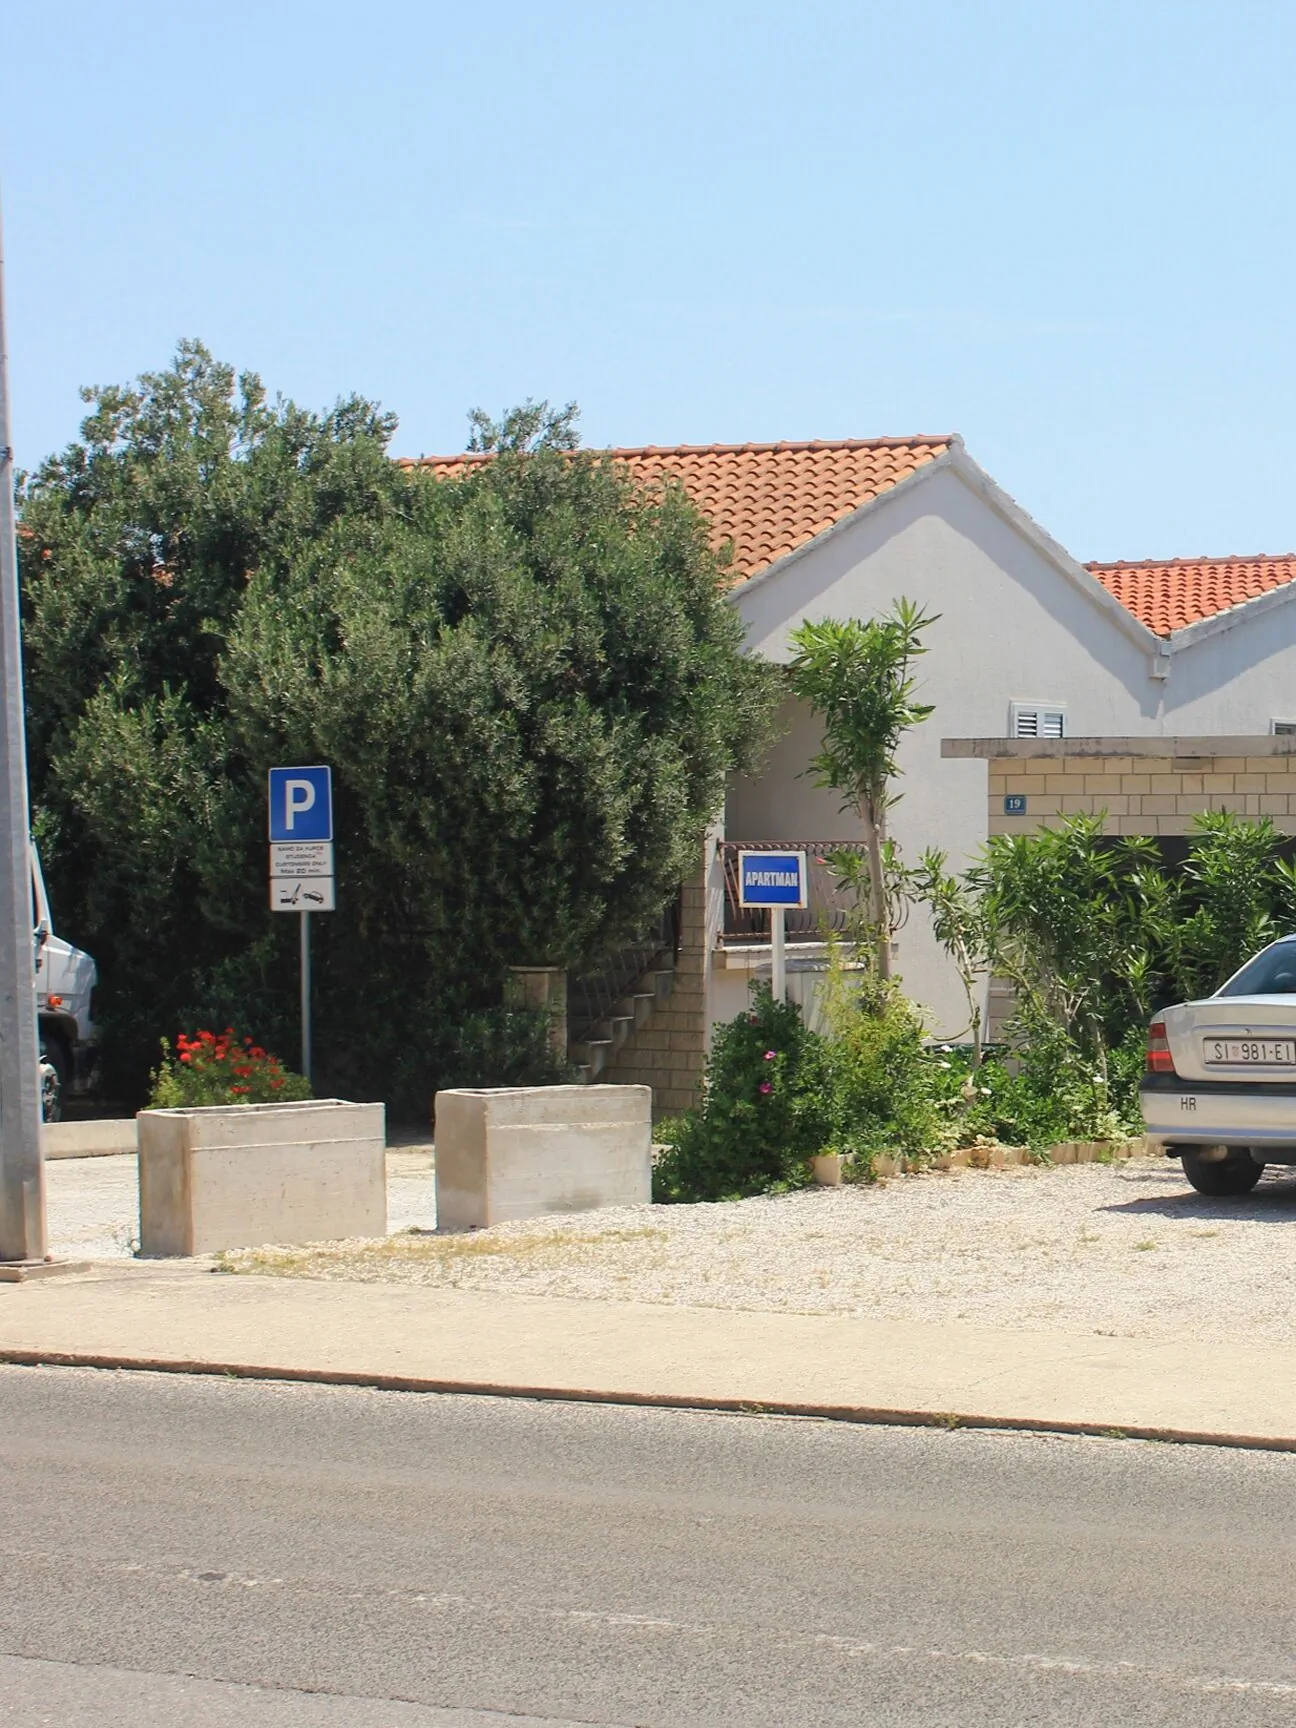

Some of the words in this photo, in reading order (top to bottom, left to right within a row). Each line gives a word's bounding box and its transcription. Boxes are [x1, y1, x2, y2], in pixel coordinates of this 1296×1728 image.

[286, 780, 316, 830] P
[1009, 799, 1021, 809] 19
[745, 871, 798, 887] APARTMAN
[1241, 1043, 1290, 1061] 981-EI
[1180, 1097, 1197, 1111] HR
